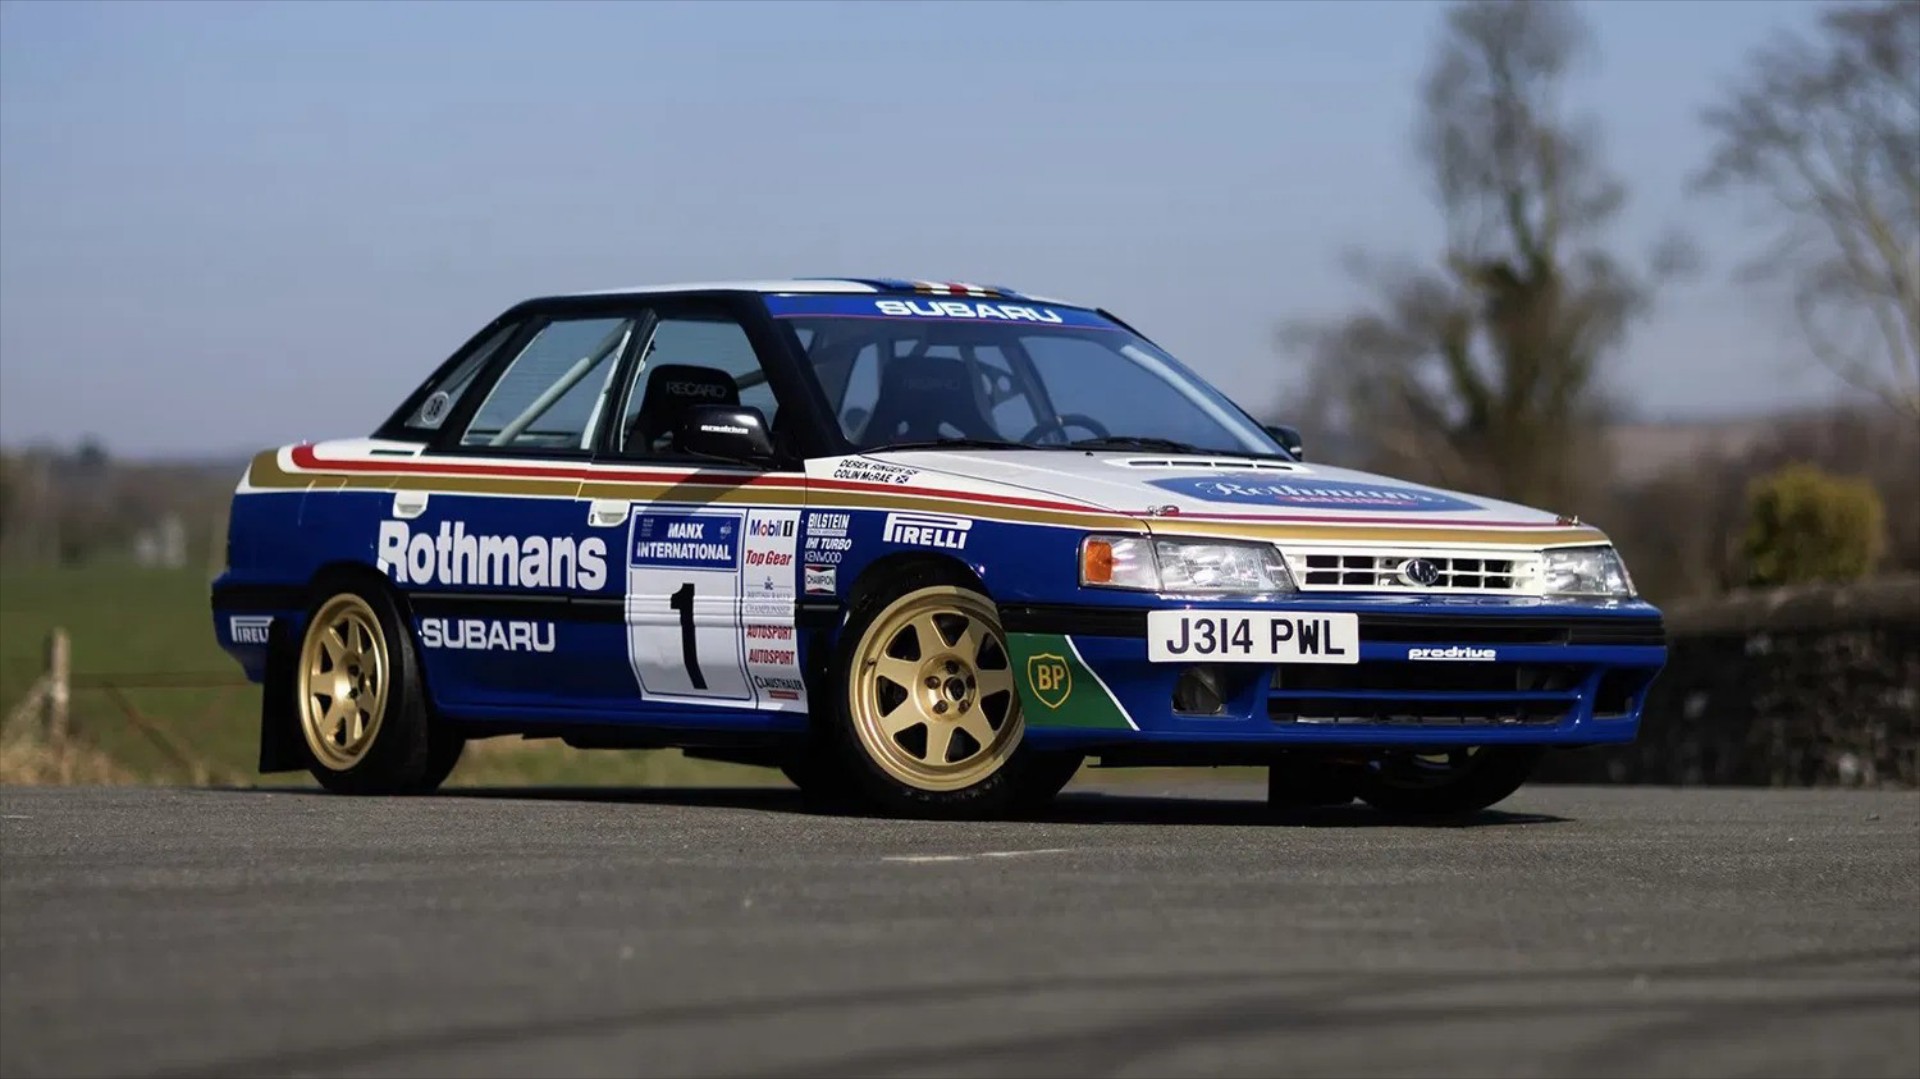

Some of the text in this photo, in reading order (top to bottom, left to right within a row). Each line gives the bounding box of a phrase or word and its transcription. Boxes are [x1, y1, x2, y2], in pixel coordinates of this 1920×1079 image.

[875, 300, 1063, 324] SUBARU
[665, 381, 727, 398] RECARO
[839, 459, 870, 470] DEREK
[834, 469, 893, 483] COLIN McRAE
[750, 519, 782, 537] Mobil
[783, 520, 795, 537] 1
[807, 512, 850, 529] BILSTEIN
[667, 522, 705, 539] MANX
[883, 512, 973, 550] PIRELLI
[636, 541, 732, 561] INTERNATIONAL
[821, 537, 852, 551] TURBO
[377, 520, 608, 591] Rothmans
[746, 549, 792, 567] Top Gear
[804, 550, 842, 563] KENWOOD
[422, 618, 556, 652] SUBARU
[670, 583, 709, 690] 1
[746, 625, 792, 640] AUTOSPORT
[1166, 617, 1346, 656] J314 PWL
[749, 648, 795, 665] AUTOSPORT
[1408, 645, 1496, 661] prodrive
[1038, 664, 1065, 691] BP
